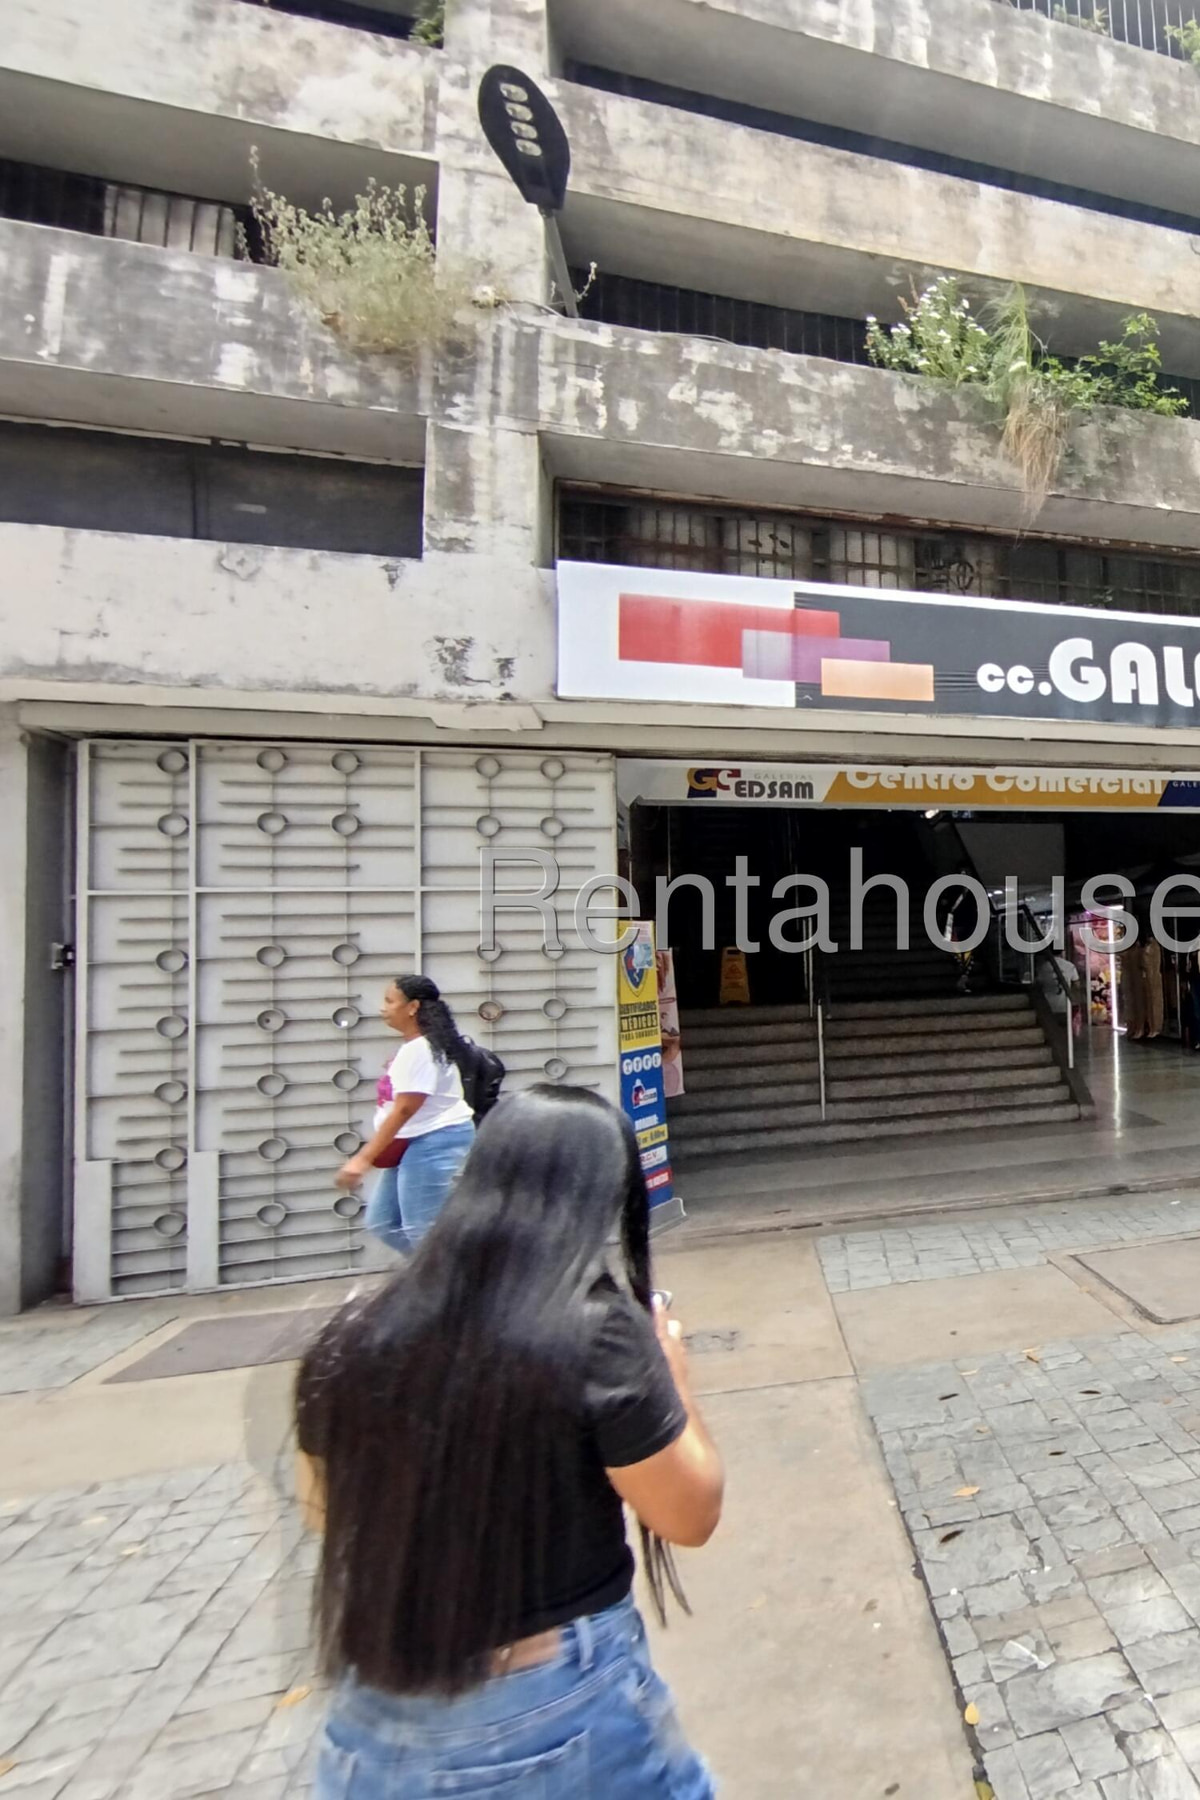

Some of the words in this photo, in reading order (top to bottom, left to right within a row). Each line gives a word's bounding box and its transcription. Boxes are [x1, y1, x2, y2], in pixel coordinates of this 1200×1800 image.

[734, 780, 814, 799] EDSAM
[846, 771, 975, 790] Centro
[985, 774, 1163, 794] Comercial
